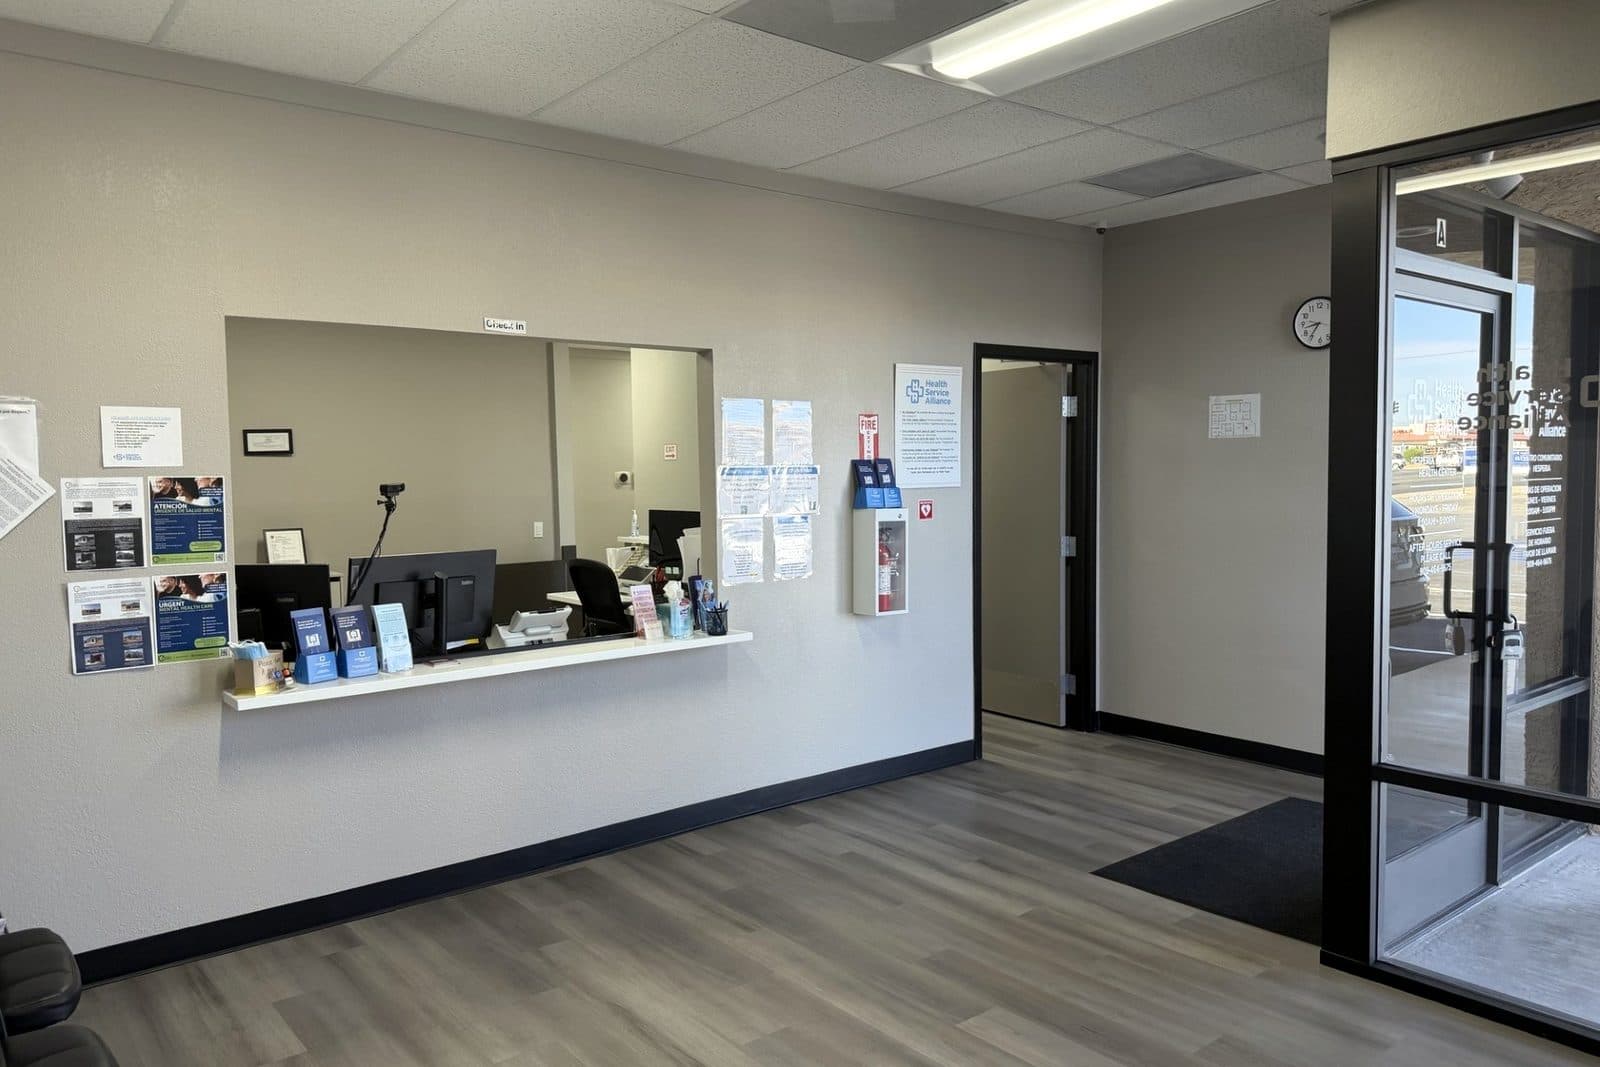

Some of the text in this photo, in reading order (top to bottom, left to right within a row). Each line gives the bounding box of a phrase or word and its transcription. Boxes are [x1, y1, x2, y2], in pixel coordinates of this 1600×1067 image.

[1438, 220, 1445, 245] A
[925, 379, 948, 388] Health
[925, 389, 949, 397] Service
[925, 397, 951, 405] Alliance
[860, 419, 877, 430] FIRE
[159, 600, 185, 608] URGENT
